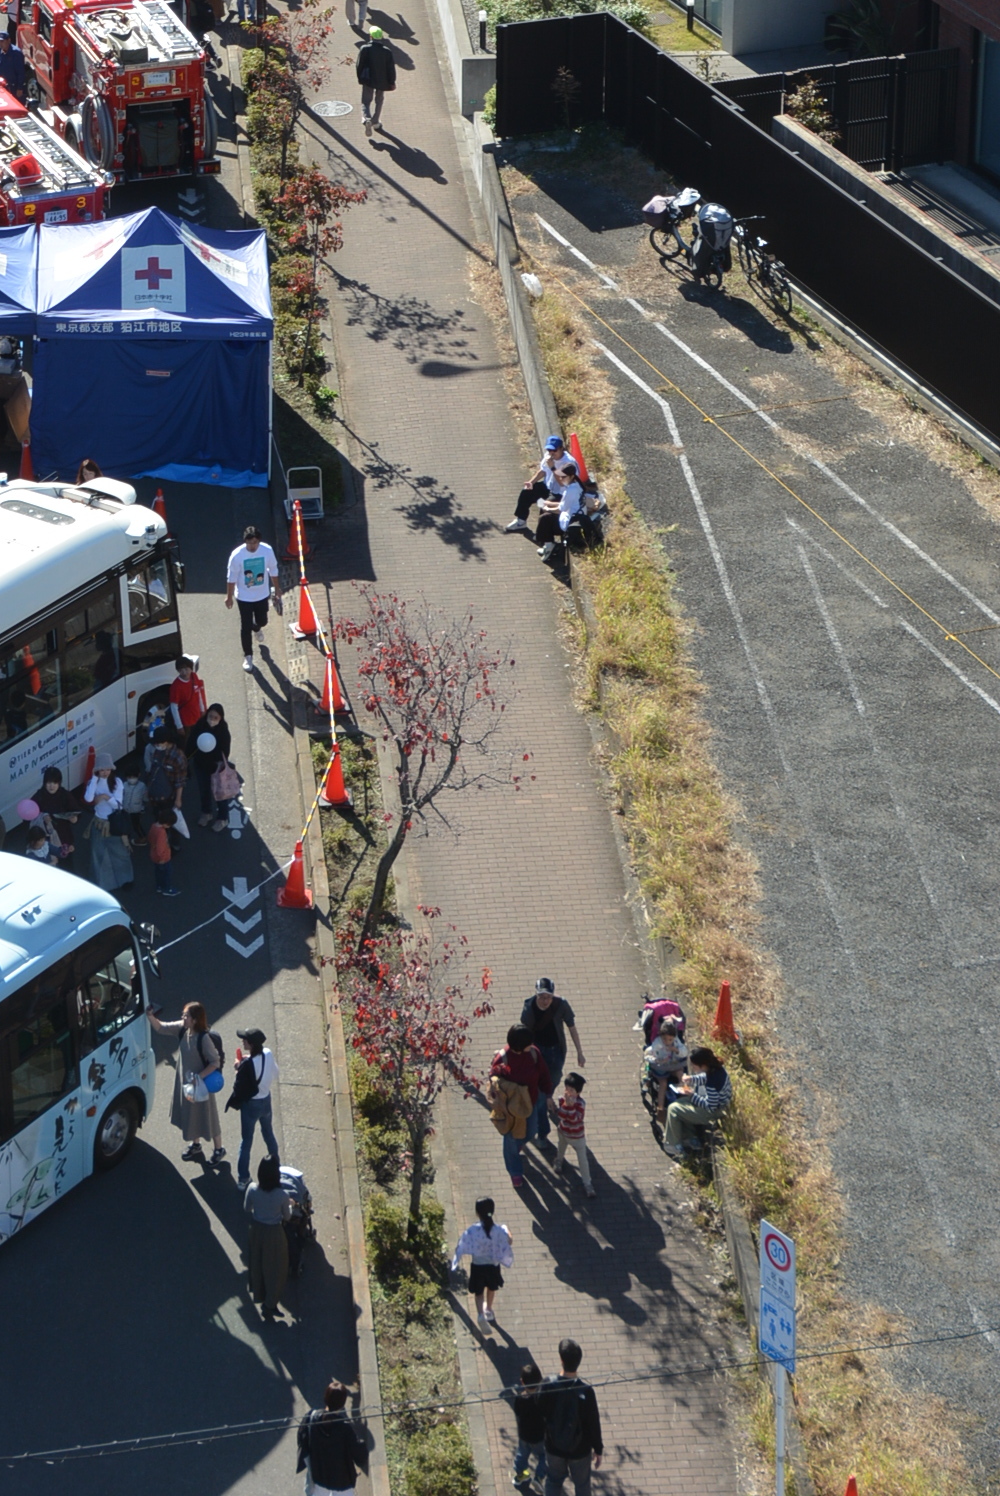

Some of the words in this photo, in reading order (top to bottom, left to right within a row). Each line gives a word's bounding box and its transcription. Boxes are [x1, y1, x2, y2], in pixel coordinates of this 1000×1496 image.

[76, 196, 87, 208] 3
[55, 322, 114, 333] 東京都支部
[120, 321, 182, 333] 狛江市地区
[770, 1242, 786, 1264] 30
